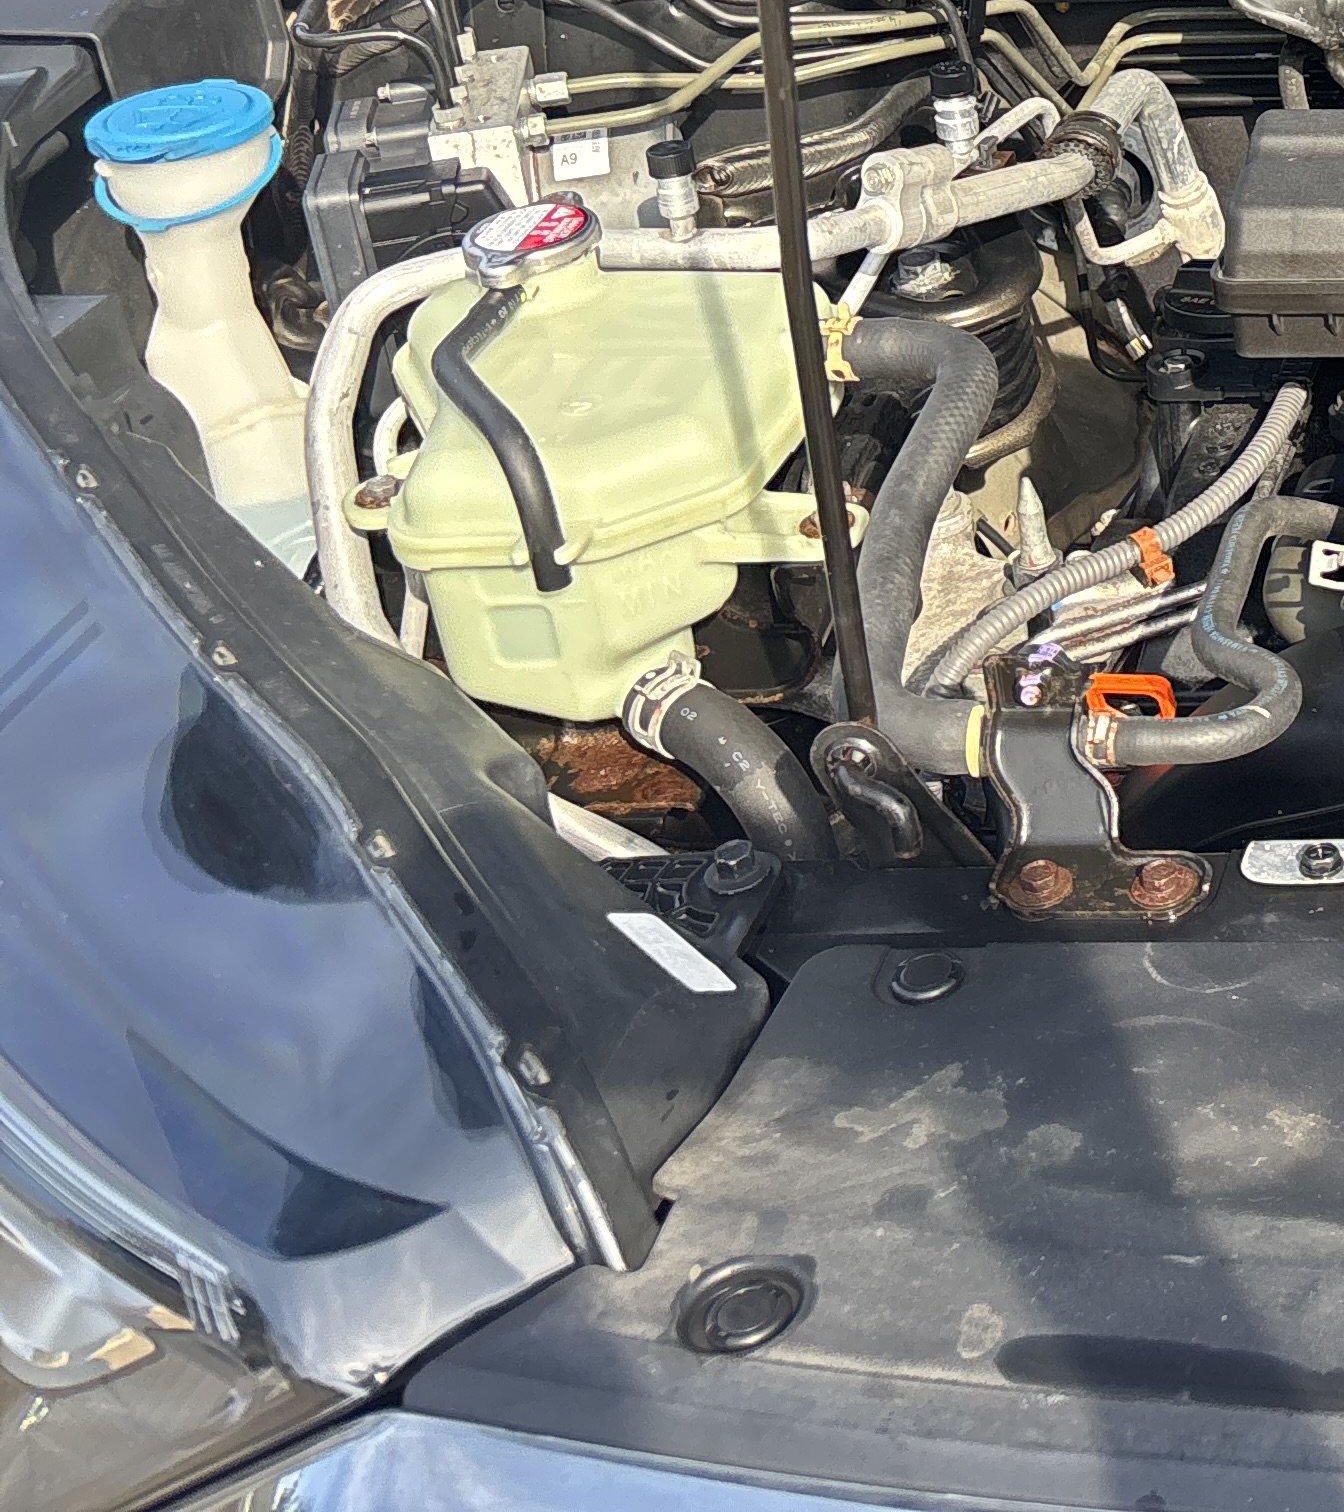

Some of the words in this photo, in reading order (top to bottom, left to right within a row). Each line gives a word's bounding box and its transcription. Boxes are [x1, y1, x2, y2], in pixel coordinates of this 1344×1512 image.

[560, 152, 578, 167] A9
[731, 750, 751, 772] C2
[755, 777, 788, 835] Y-TEC
